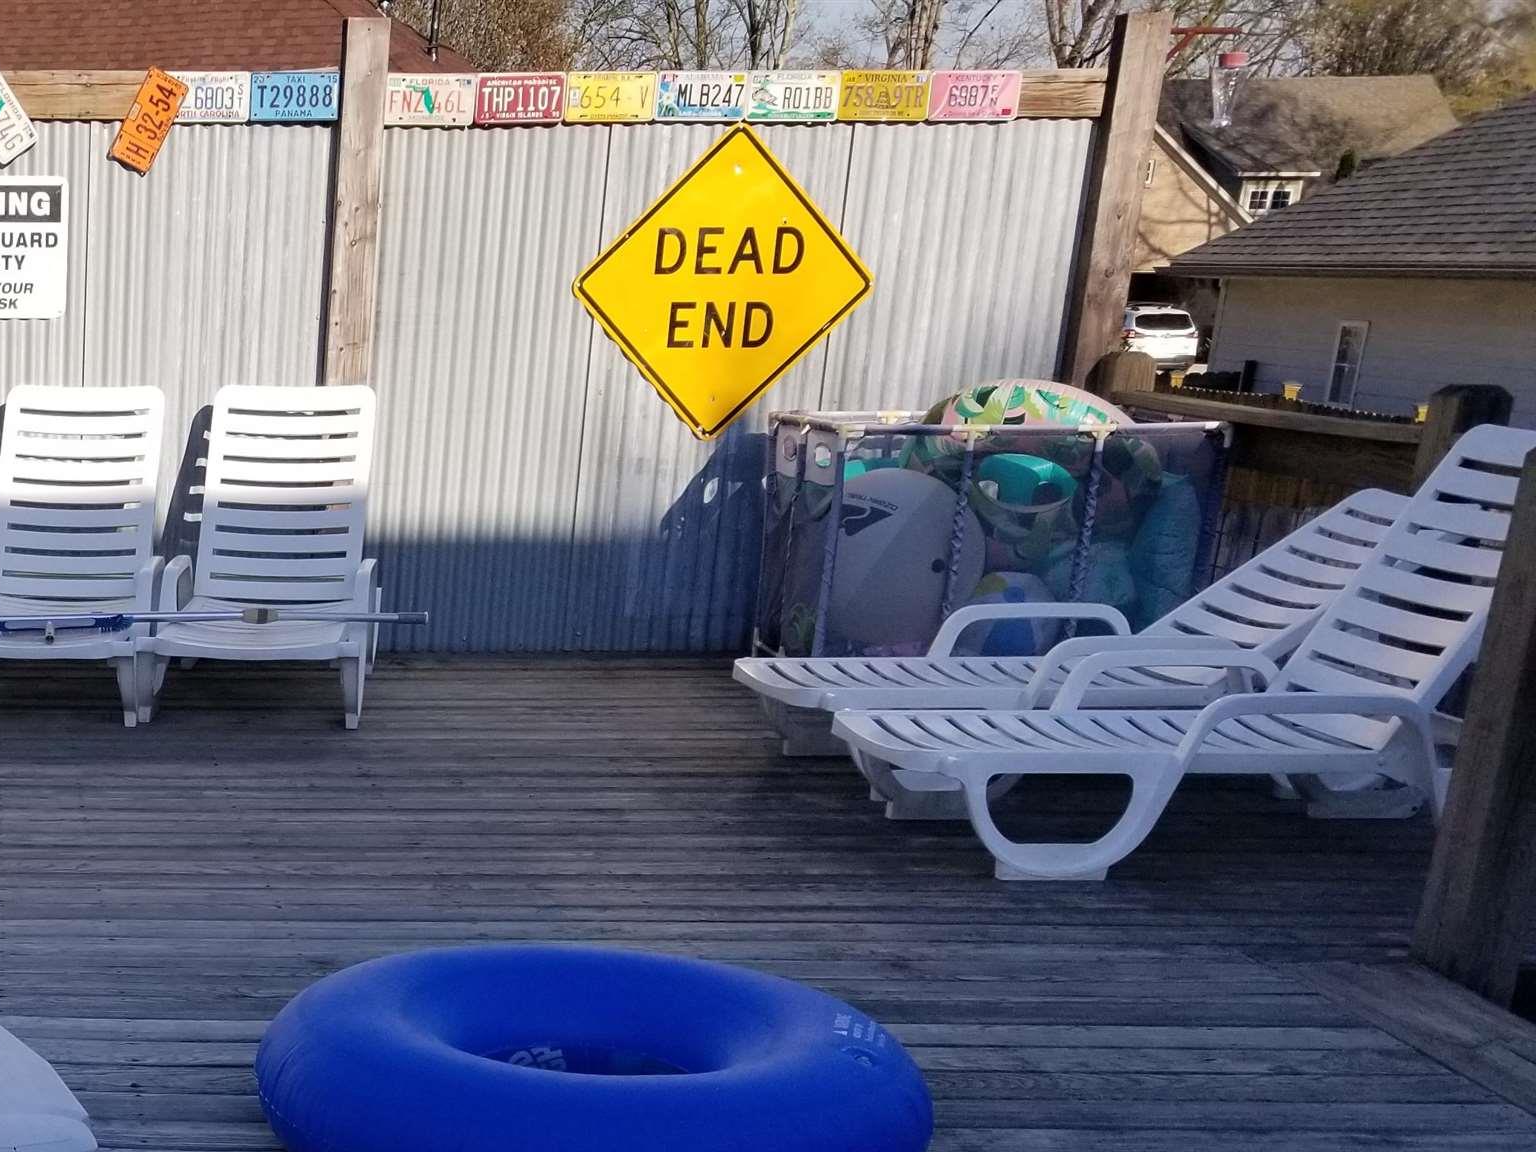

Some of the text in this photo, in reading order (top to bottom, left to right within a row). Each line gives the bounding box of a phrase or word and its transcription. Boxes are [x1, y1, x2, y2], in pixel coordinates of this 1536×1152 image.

[864, 73, 907, 83] VIRGINIA
[257, 84, 333, 109] T29888
[389, 90, 425, 113] FNZ
[482, 86, 561, 112] THP1107
[579, 85, 621, 109] 654
[678, 83, 745, 108] MLB247
[843, 86, 874, 109] 758
[135, 83, 177, 141] 32-54
[654, 226, 806, 275] DEAD
[667, 301, 774, 349] END
